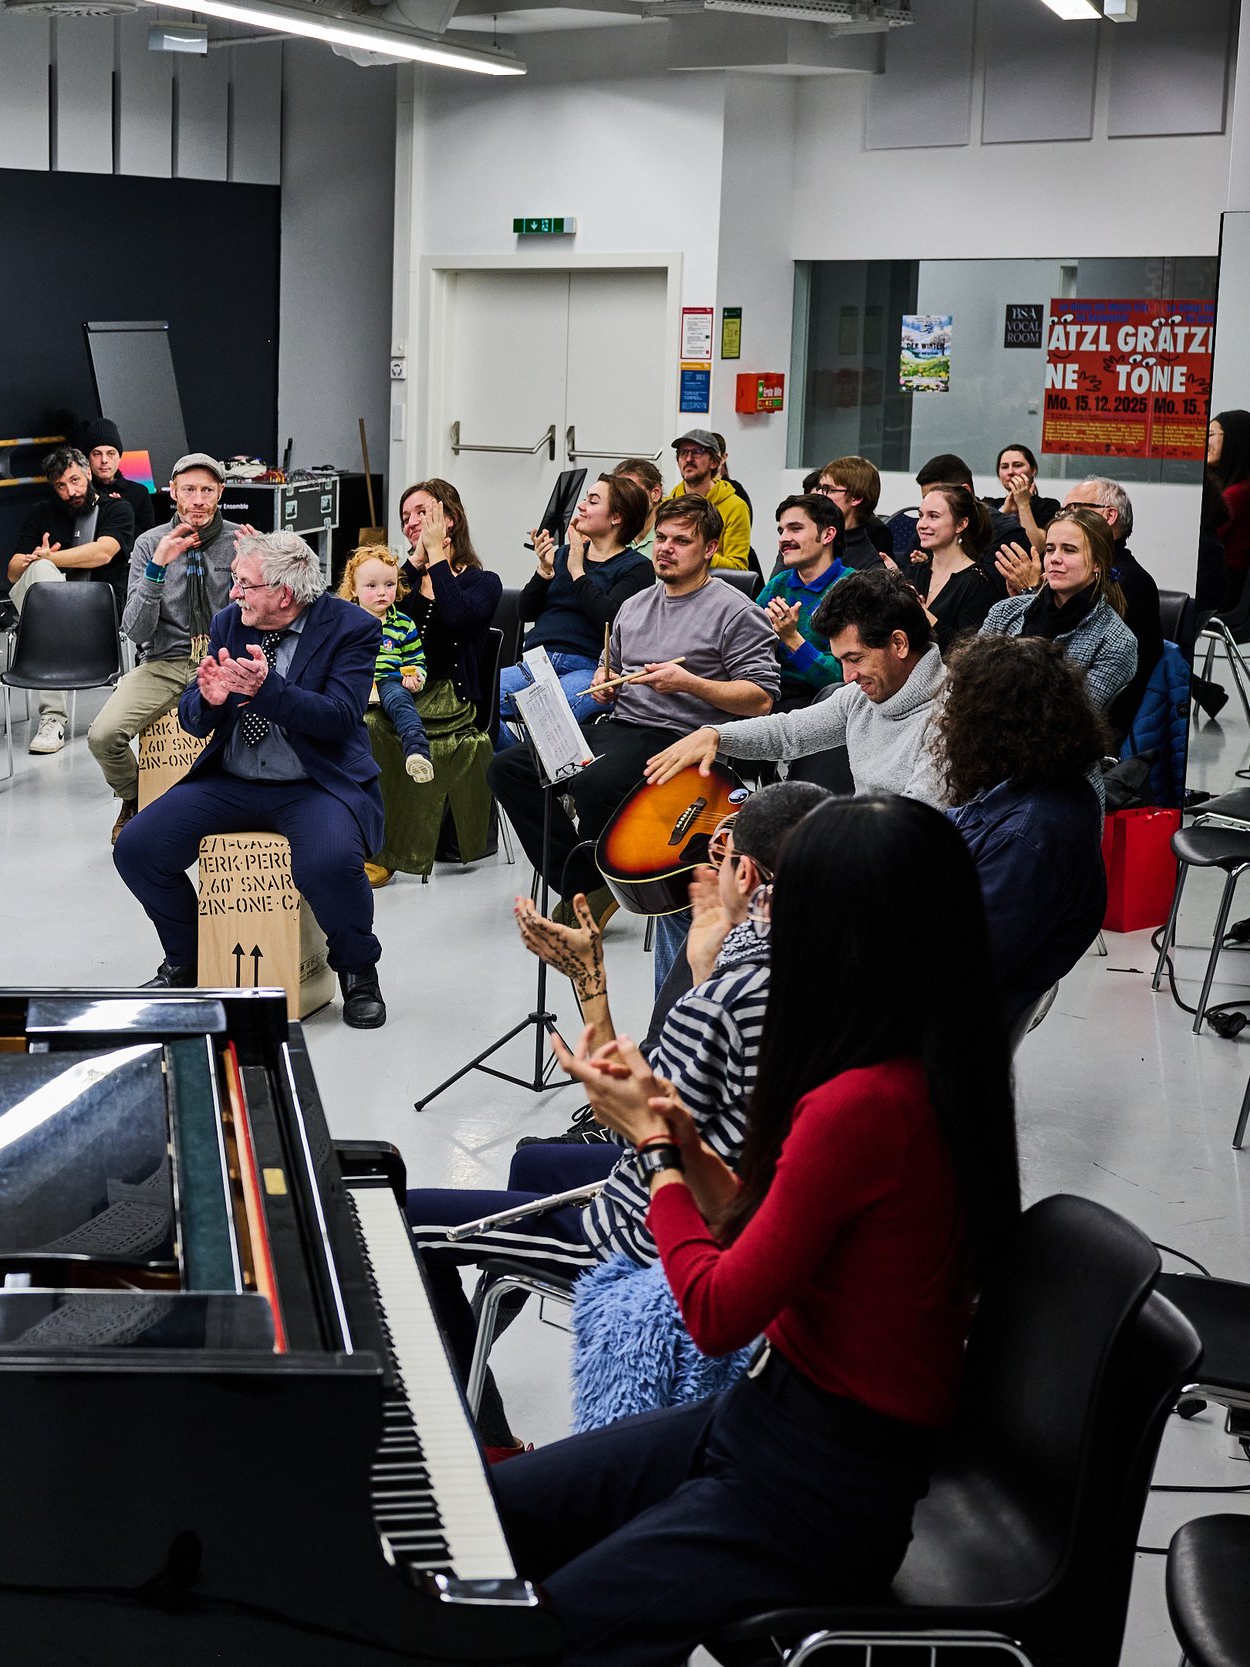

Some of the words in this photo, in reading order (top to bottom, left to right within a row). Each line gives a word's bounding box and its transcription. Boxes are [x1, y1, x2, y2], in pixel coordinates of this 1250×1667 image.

[1012, 307, 1037, 320] BSA
[1007, 320, 1042, 332] VOCAL
[1007, 332, 1039, 343] ROOM
[1116, 354, 1188, 395] TÖNE
[1047, 394, 1071, 411] Mo.
[1075, 395, 1092, 412] 15.
[1094, 395, 1111, 412] 12.
[1114, 396, 1148, 413] 2025
[1154, 397, 1179, 415] Mo.
[1183, 398, 1201, 415] 15.
